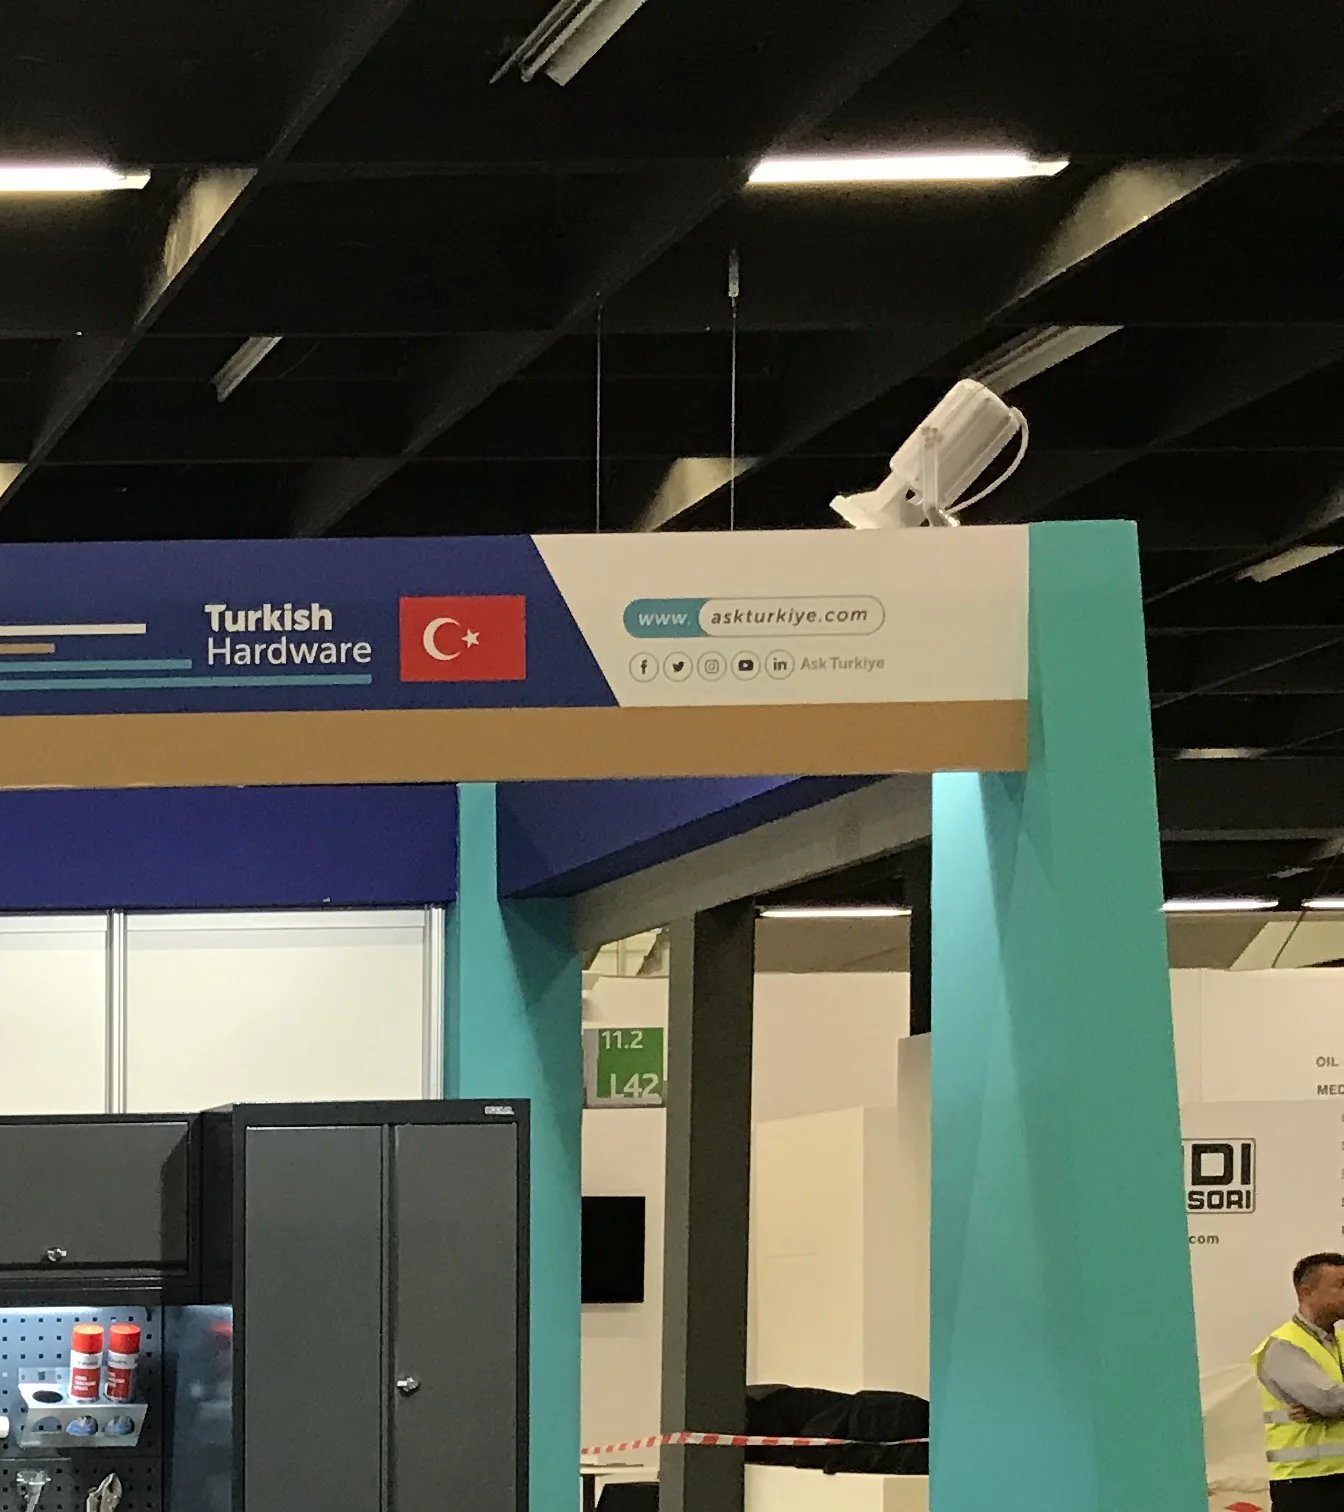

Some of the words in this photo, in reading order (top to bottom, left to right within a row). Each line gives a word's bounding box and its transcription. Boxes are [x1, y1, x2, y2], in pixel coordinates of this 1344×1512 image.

[204, 602, 333, 633] Turkish
[638, 611, 692, 627] www.
[710, 606, 869, 627] askturkiye.com
[207, 635, 372, 666] Hardware
[800, 656, 828, 671] Ask
[831, 654, 885, 672] Turkiye
[601, 1030, 644, 1049] 11.2
[1315, 1056, 1340, 1068] OIL
[610, 1073, 660, 1098] L42
[1181, 1143, 1252, 1186] DI
